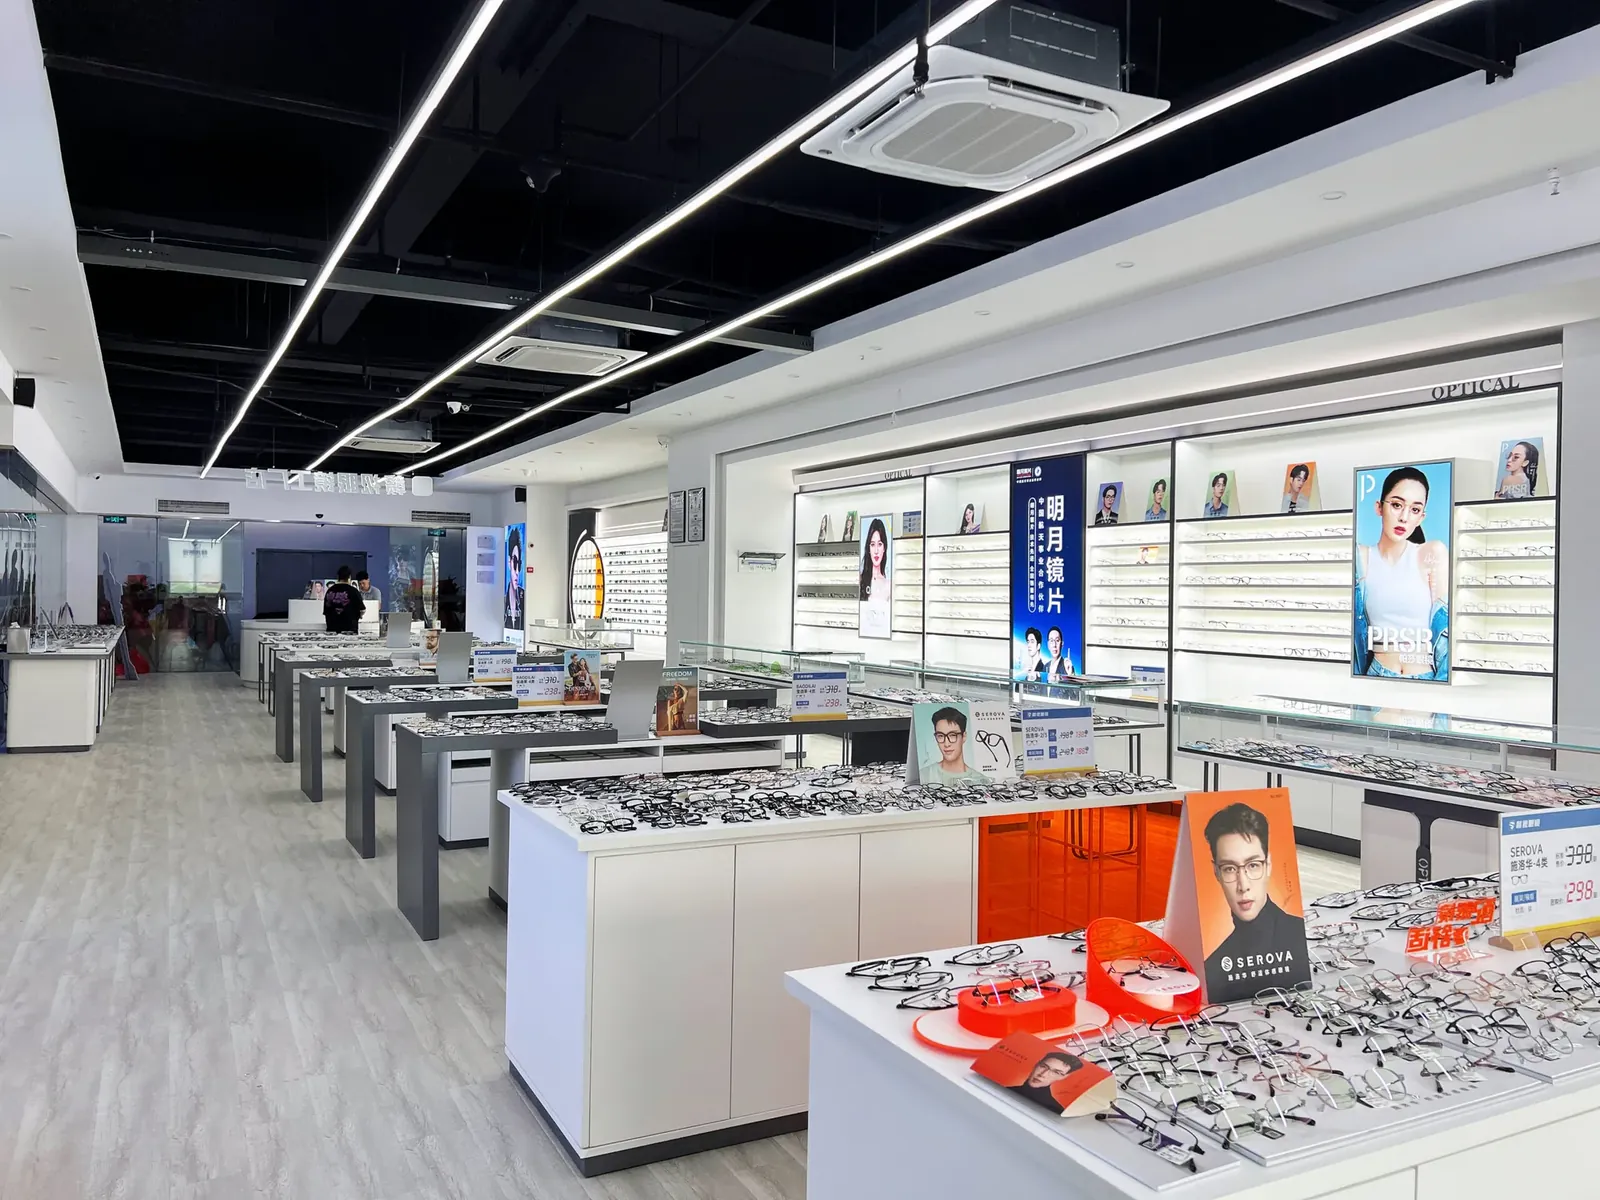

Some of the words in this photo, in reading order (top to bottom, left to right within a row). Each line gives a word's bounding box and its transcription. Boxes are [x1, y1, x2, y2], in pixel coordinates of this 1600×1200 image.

[1431, 374, 1520, 400] OPTICAL
[884, 469, 913, 480] OPTICAL
[1046, 494, 1065, 614] 明月镜片
[1367, 625, 1433, 653] PRSR
[662, 670, 693, 678] FREEDOM
[544, 688, 559, 696] 238
[824, 698, 840, 708] 238
[1510, 843, 1544, 858] SEROVA
[1236, 949, 1294, 968] SEROVA
